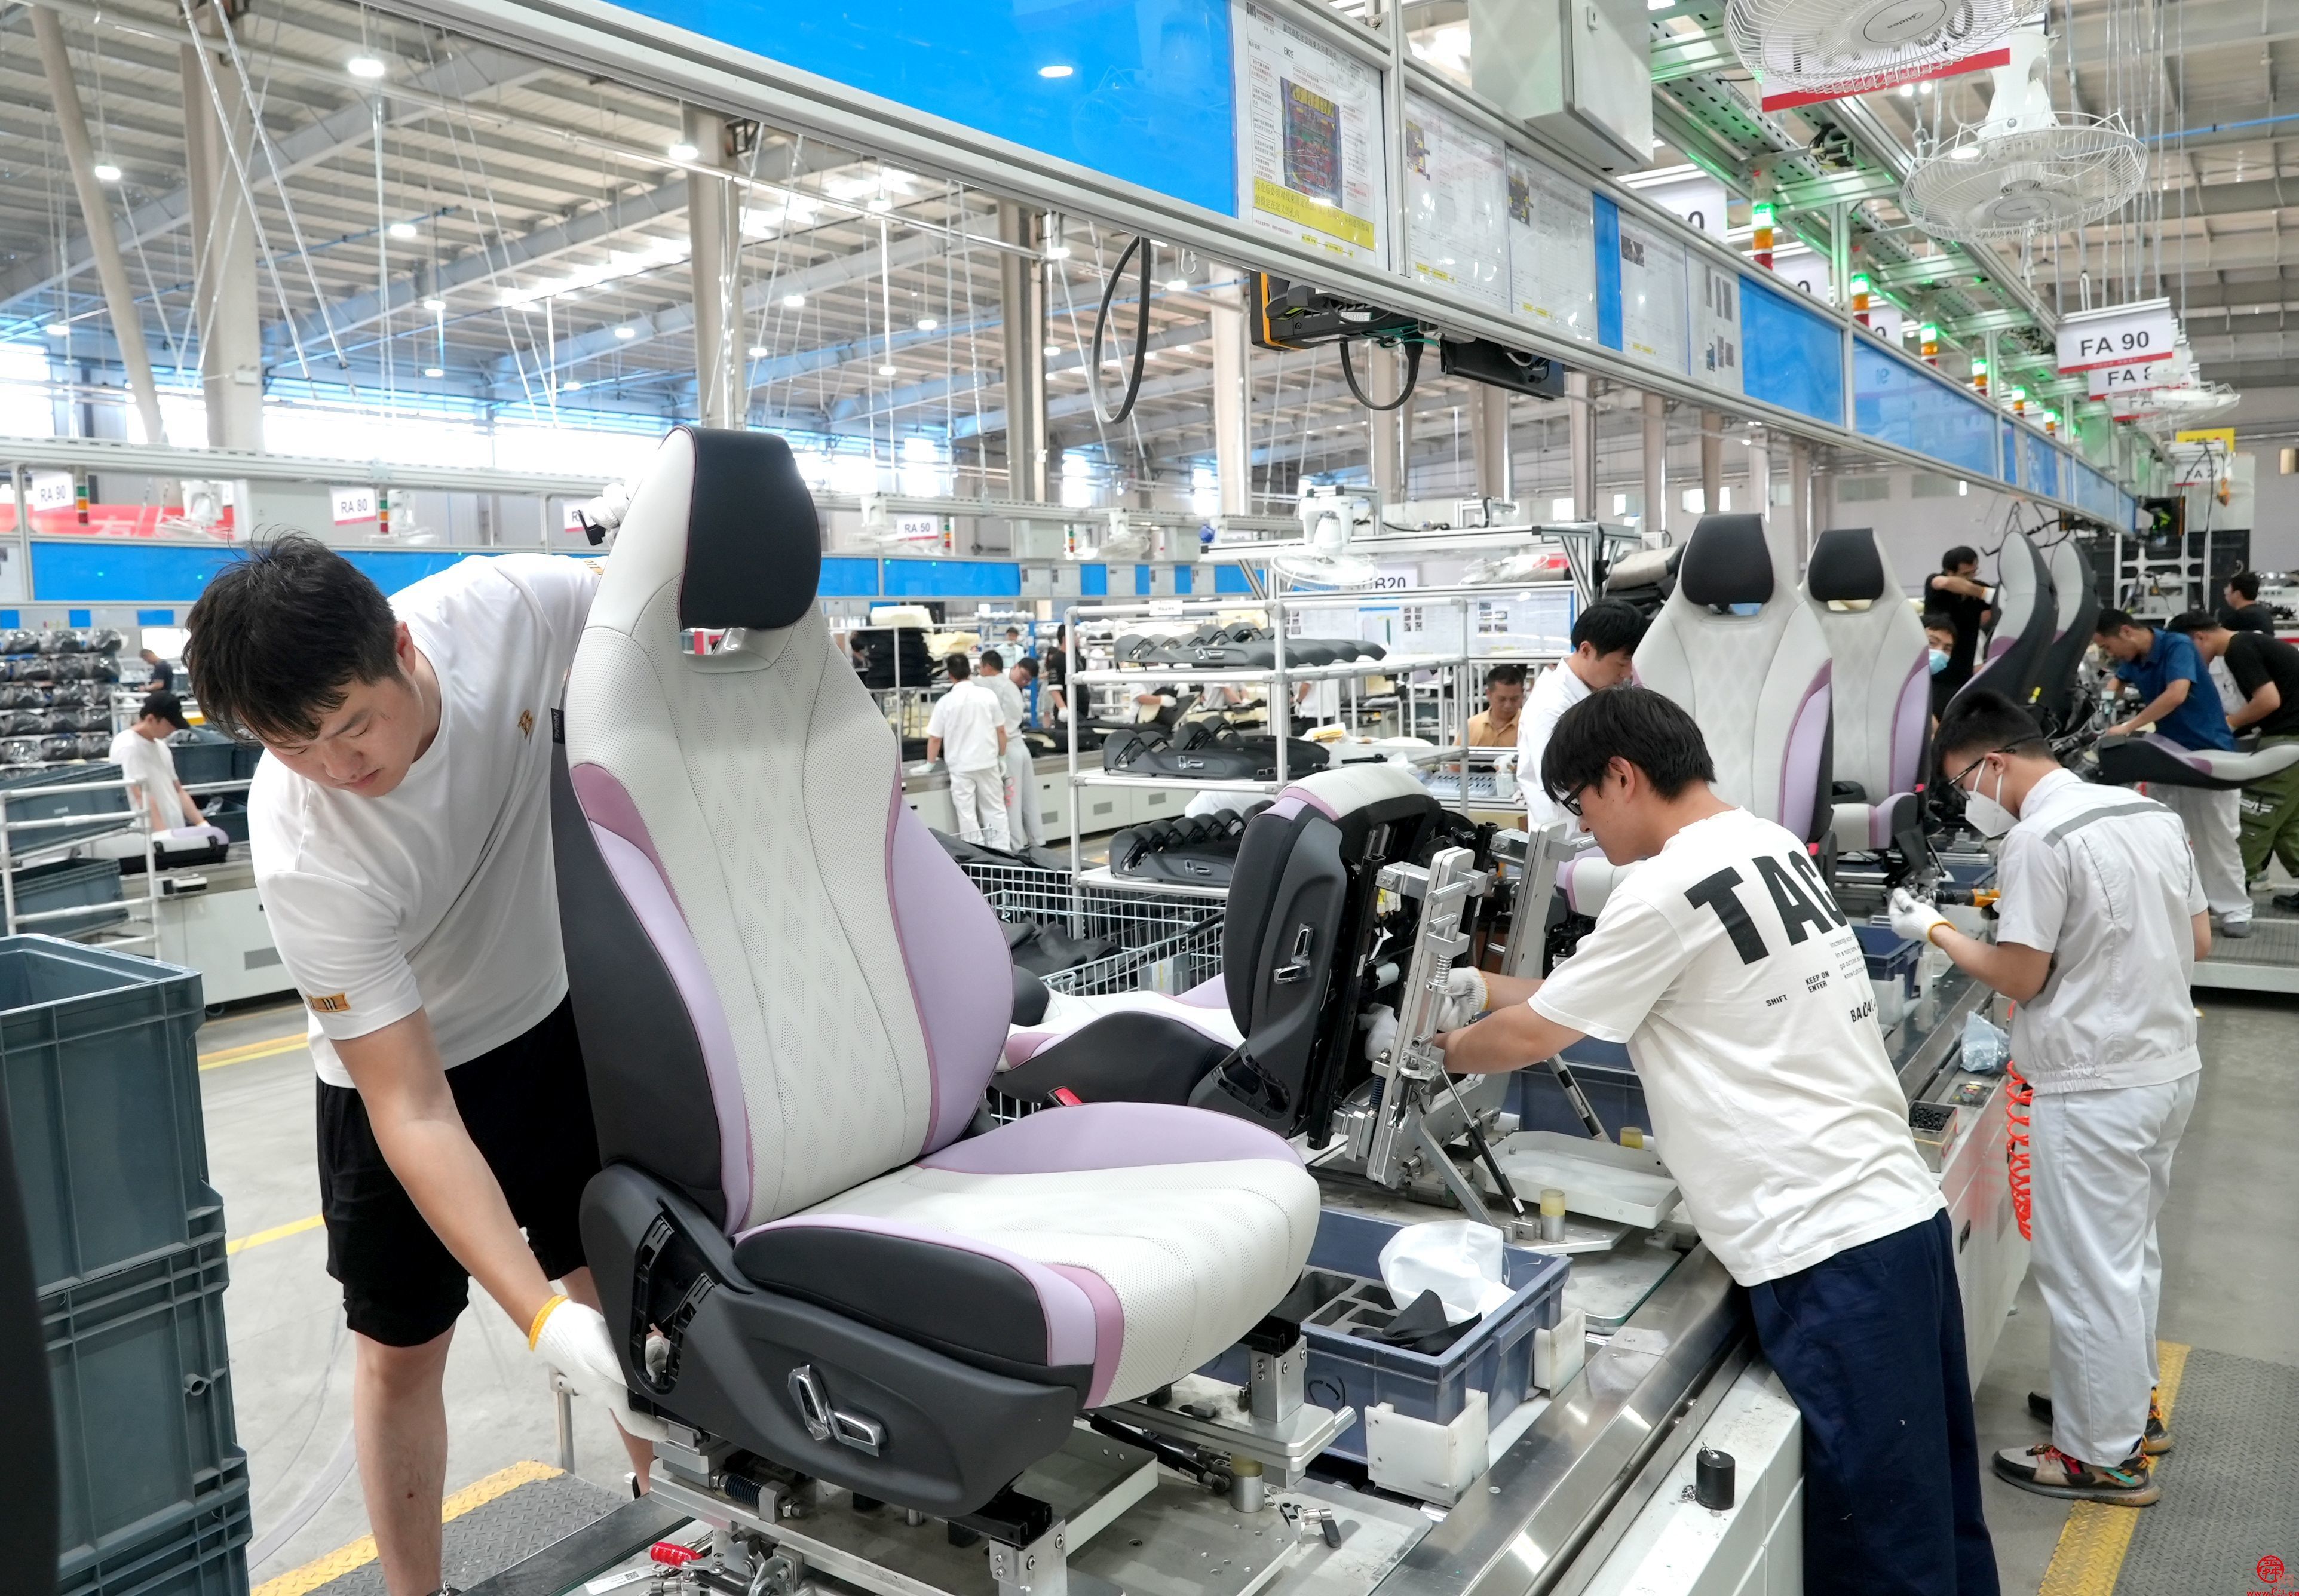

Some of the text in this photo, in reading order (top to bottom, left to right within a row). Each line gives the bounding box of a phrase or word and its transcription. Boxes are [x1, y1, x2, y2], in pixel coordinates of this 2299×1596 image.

[2080, 330, 2150, 357] FA 90
[2107, 368, 2136, 387] FA
[40, 485, 66, 502] RA 90
[341, 498, 369, 514] RA 80
[904, 522, 931, 535] RA 50
[1805, 971, 1830, 986] KEEP ON
[1808, 980, 1828, 993] ENTER
[1766, 994, 1788, 1006] SHIFT
